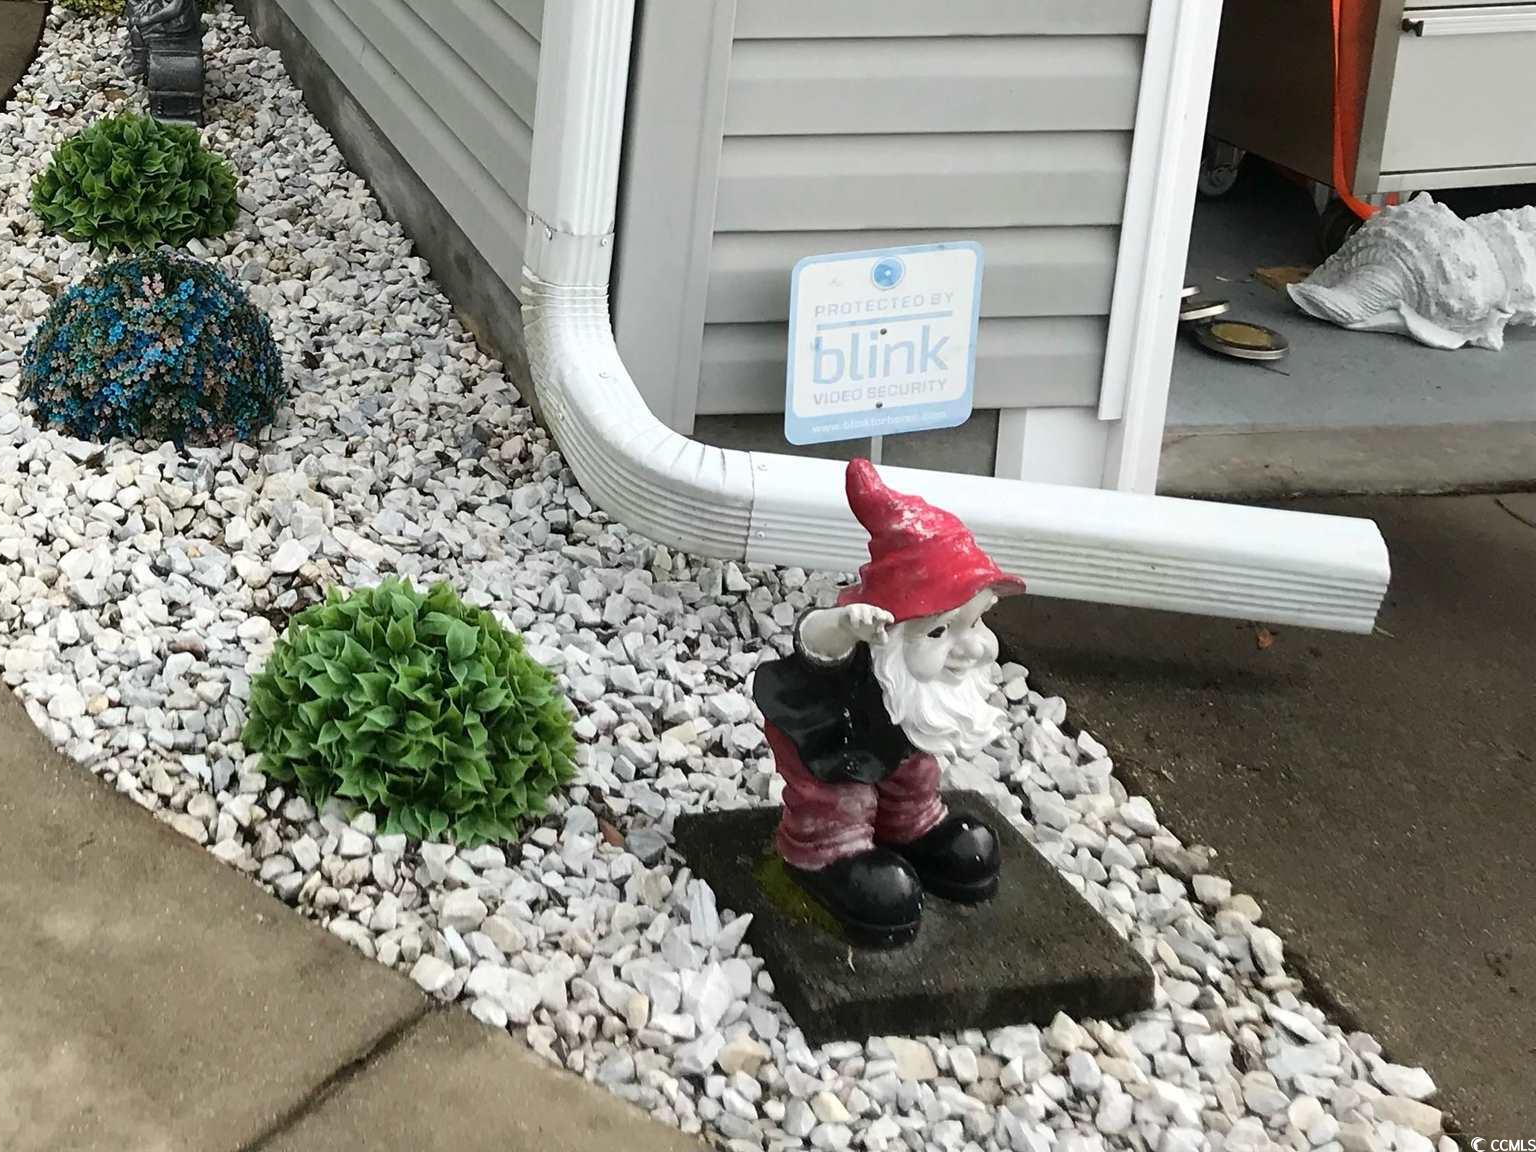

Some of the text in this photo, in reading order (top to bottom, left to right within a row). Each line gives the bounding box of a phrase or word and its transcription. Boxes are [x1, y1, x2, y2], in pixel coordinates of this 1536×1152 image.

[815, 292, 954, 317] PROTECTED BY
[812, 325, 951, 385] blink
[814, 380, 946, 405] VIDEO SECURITY
